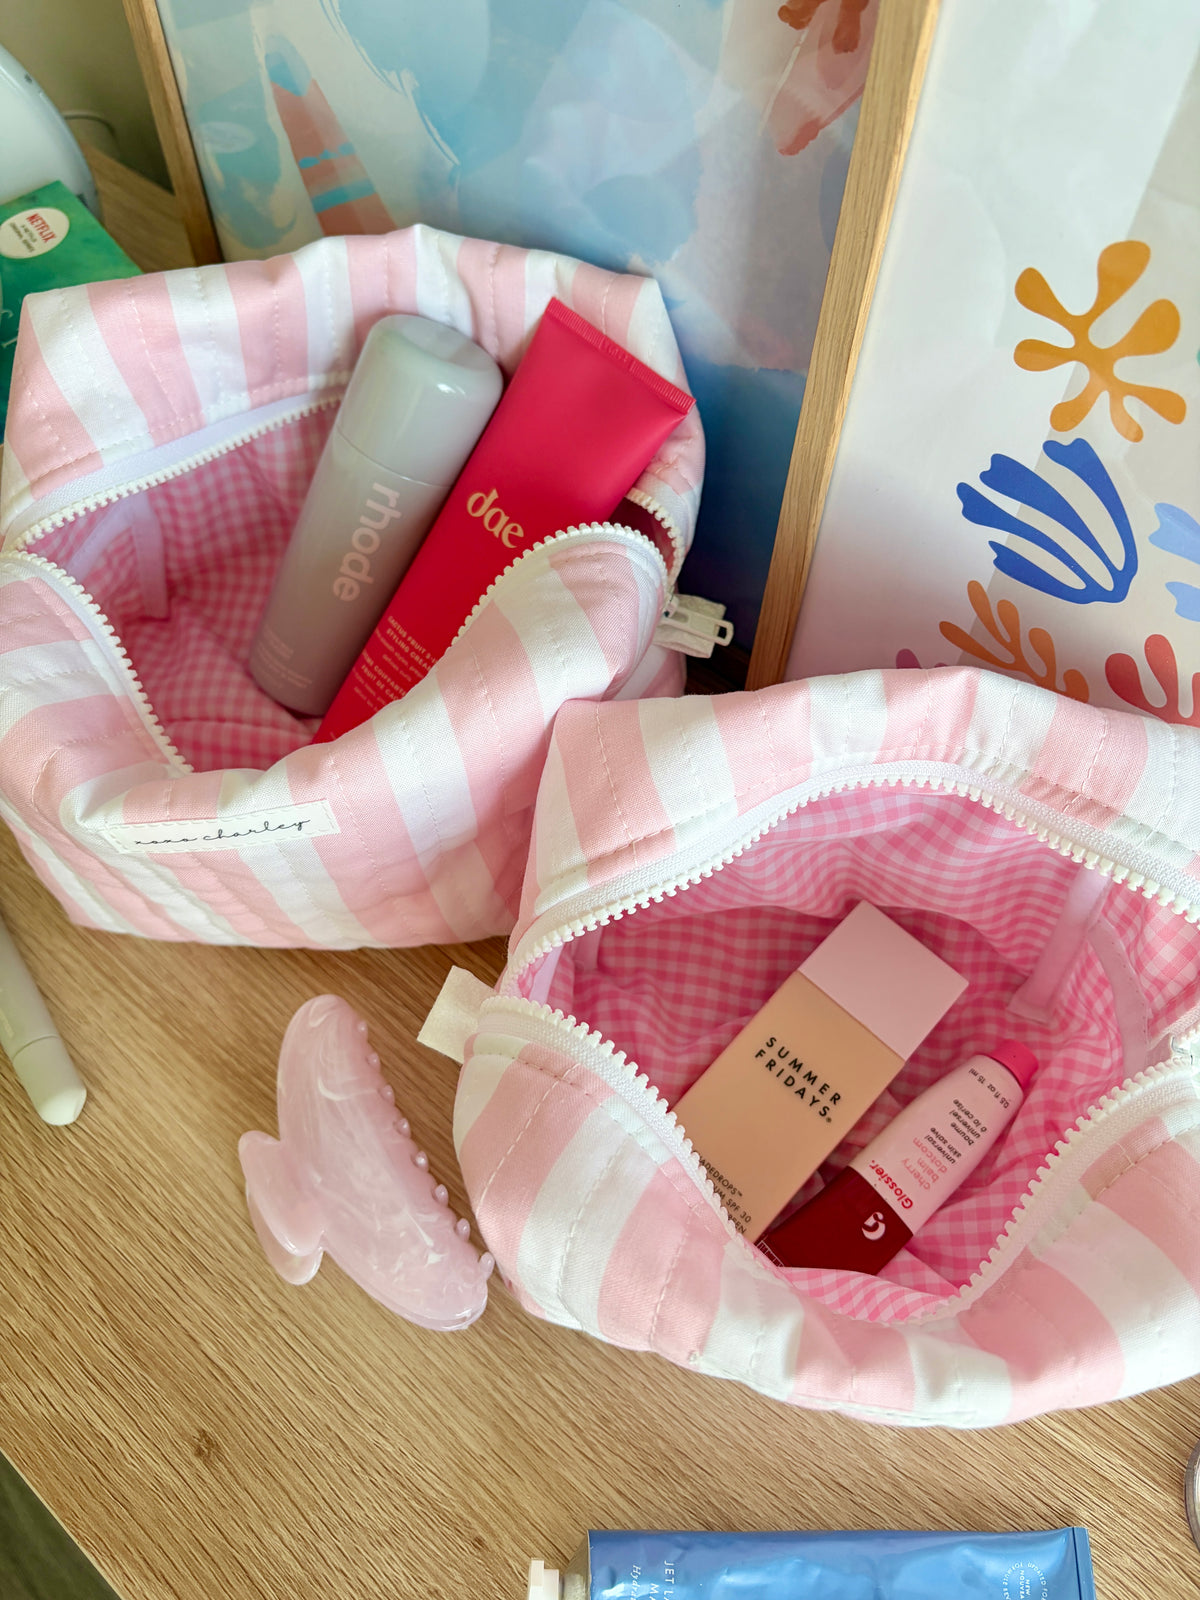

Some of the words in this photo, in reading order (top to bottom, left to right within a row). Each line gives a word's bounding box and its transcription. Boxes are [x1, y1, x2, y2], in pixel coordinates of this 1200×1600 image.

[26, 212, 57, 243] NETFLIX
[466, 488, 524, 549] dae
[332, 482, 402, 602] rhode
[386, 628, 410, 653] STYLING
[387, 615, 407, 638] CACTUS
[407, 636, 427, 654] FRUIT
[361, 664, 377, 681] FRUIT
[202, 819, 312, 842] charley
[765, 1036, 842, 1106] SUMMER
[968, 1068, 979, 1077] ml
[977, 1075, 987, 1085] 15
[987, 1083, 996, 1093] oz
[953, 1099, 975, 1120] cerise
[930, 1127, 949, 1145] salve
[949, 1109, 981, 1139] universel
[950, 1122, 975, 1146] baume
[912, 1137, 948, 1175] dotcom
[924, 1134, 957, 1165] universal
[947, 1144, 963, 1159] skin
[901, 1157, 931, 1191] cherry
[916, 1158, 940, 1184] balm
[726, 1198, 741, 1212] SPF
[740, 1211, 752, 1224] 30
[663, 1560, 675, 1585] JET
